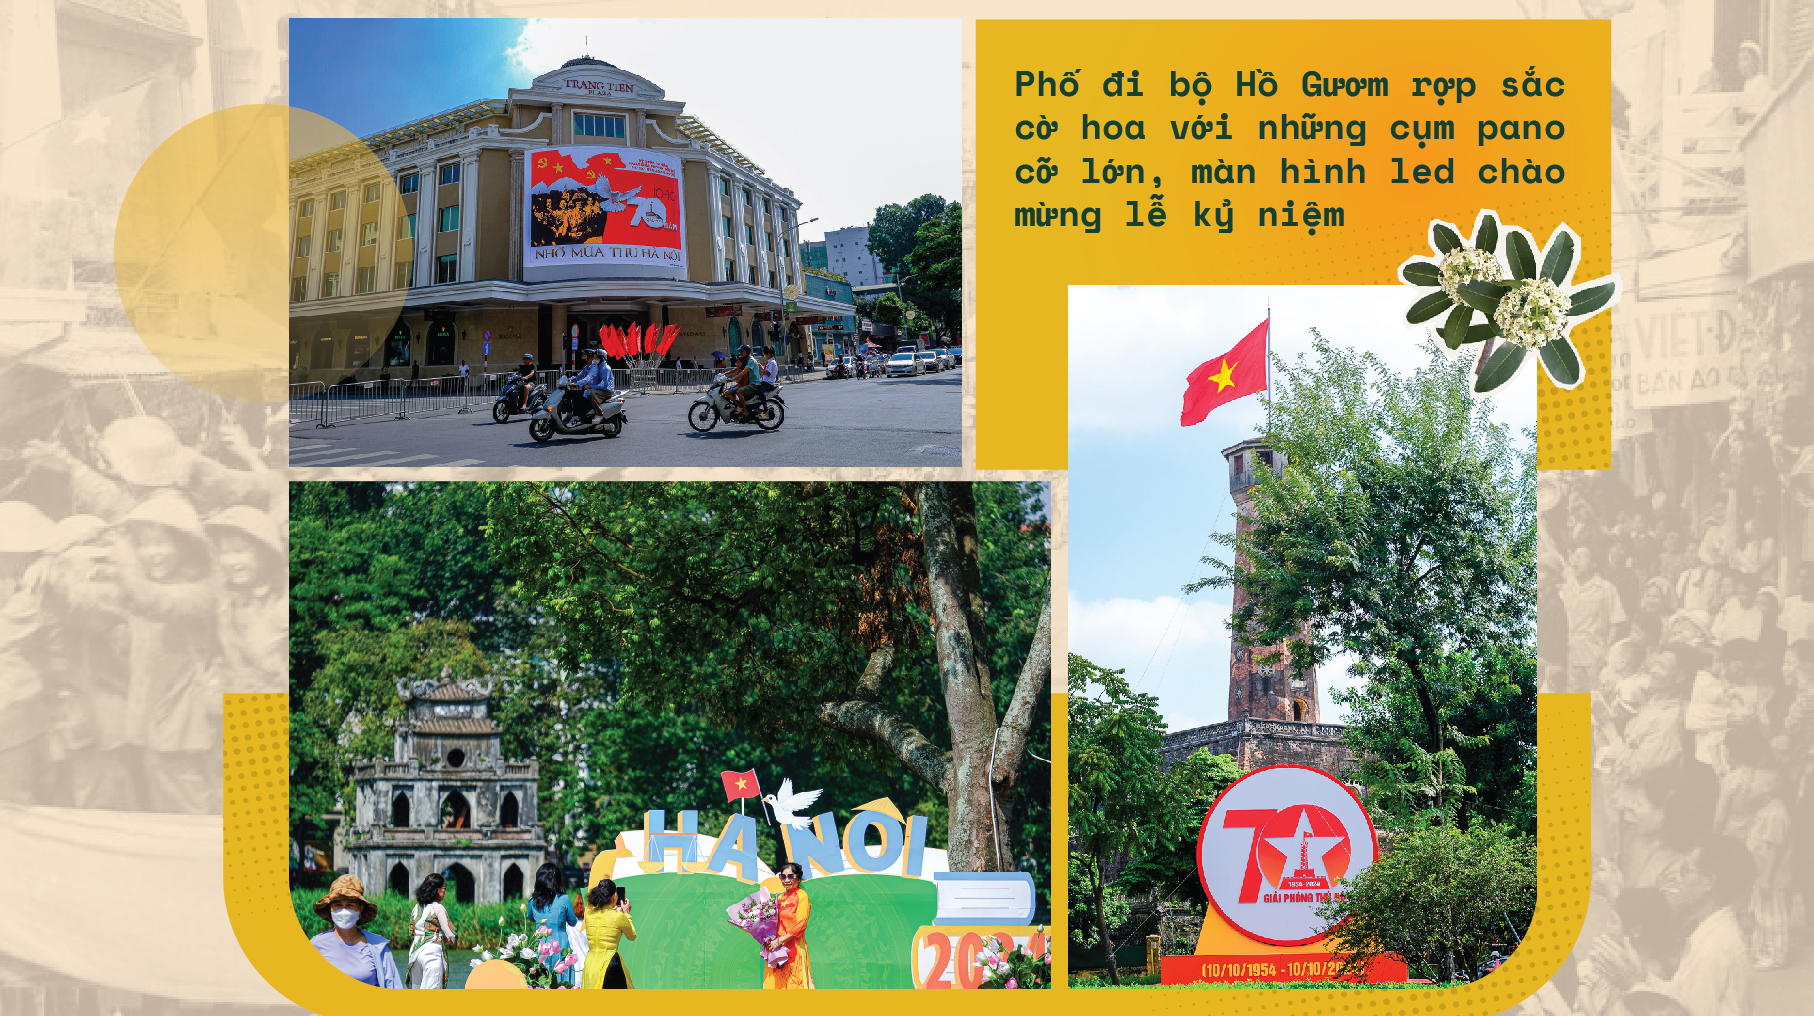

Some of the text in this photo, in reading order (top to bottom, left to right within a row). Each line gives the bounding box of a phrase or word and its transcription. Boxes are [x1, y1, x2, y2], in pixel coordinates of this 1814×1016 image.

[564, 79, 604, 90] TRANG
[609, 246, 638, 258] THU
[1222, 804, 1351, 904] 70
[1201, 963, 1276, 977] (10/10/1954
